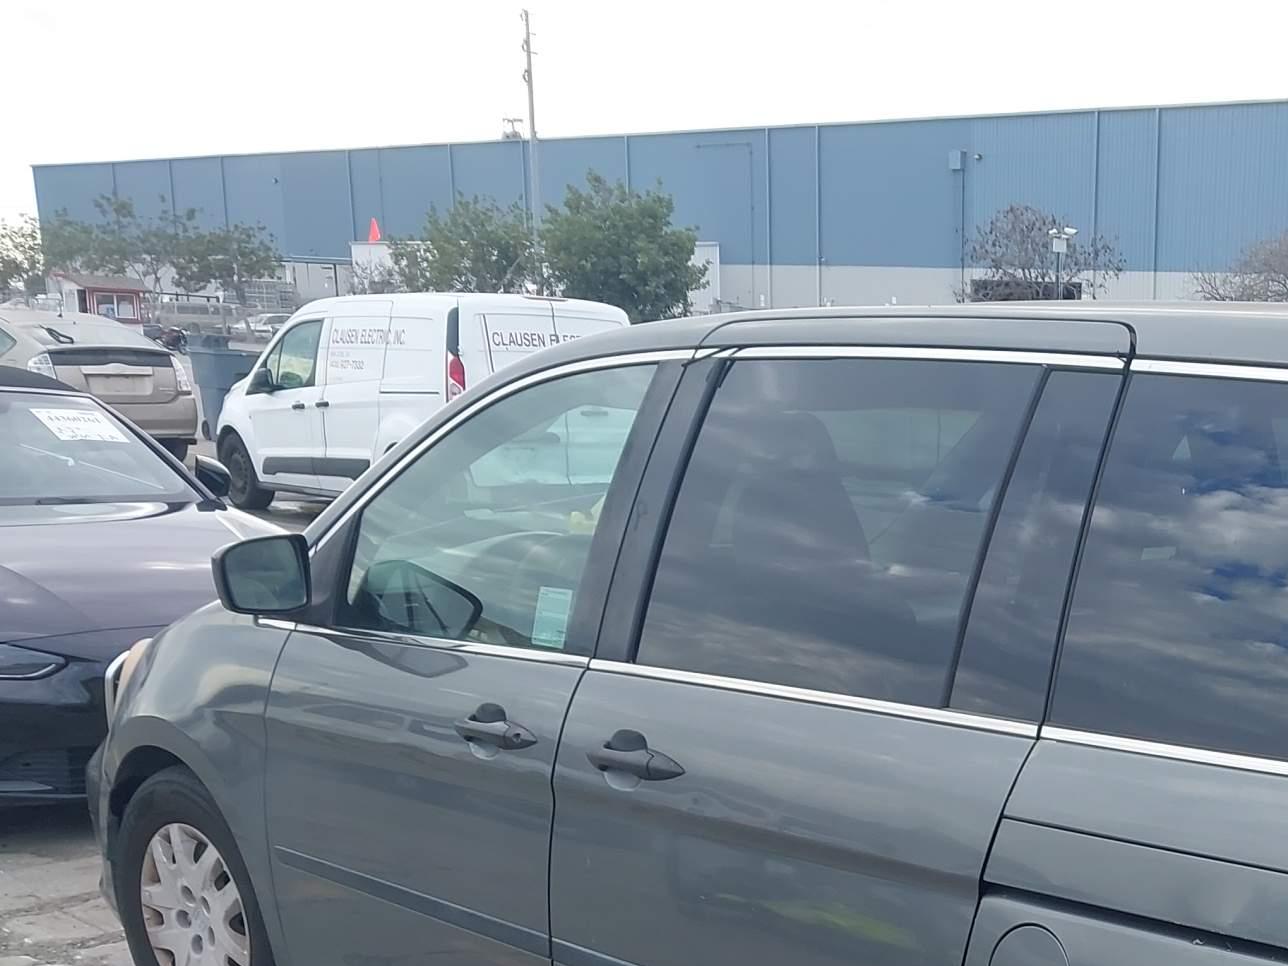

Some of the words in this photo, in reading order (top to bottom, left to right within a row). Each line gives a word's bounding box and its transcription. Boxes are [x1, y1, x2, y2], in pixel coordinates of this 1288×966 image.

[332, 328, 359, 344] CLAUSEN
[360, 328, 392, 345] ELECTRIC
[491, 331, 546, 348] CLAUSEN
